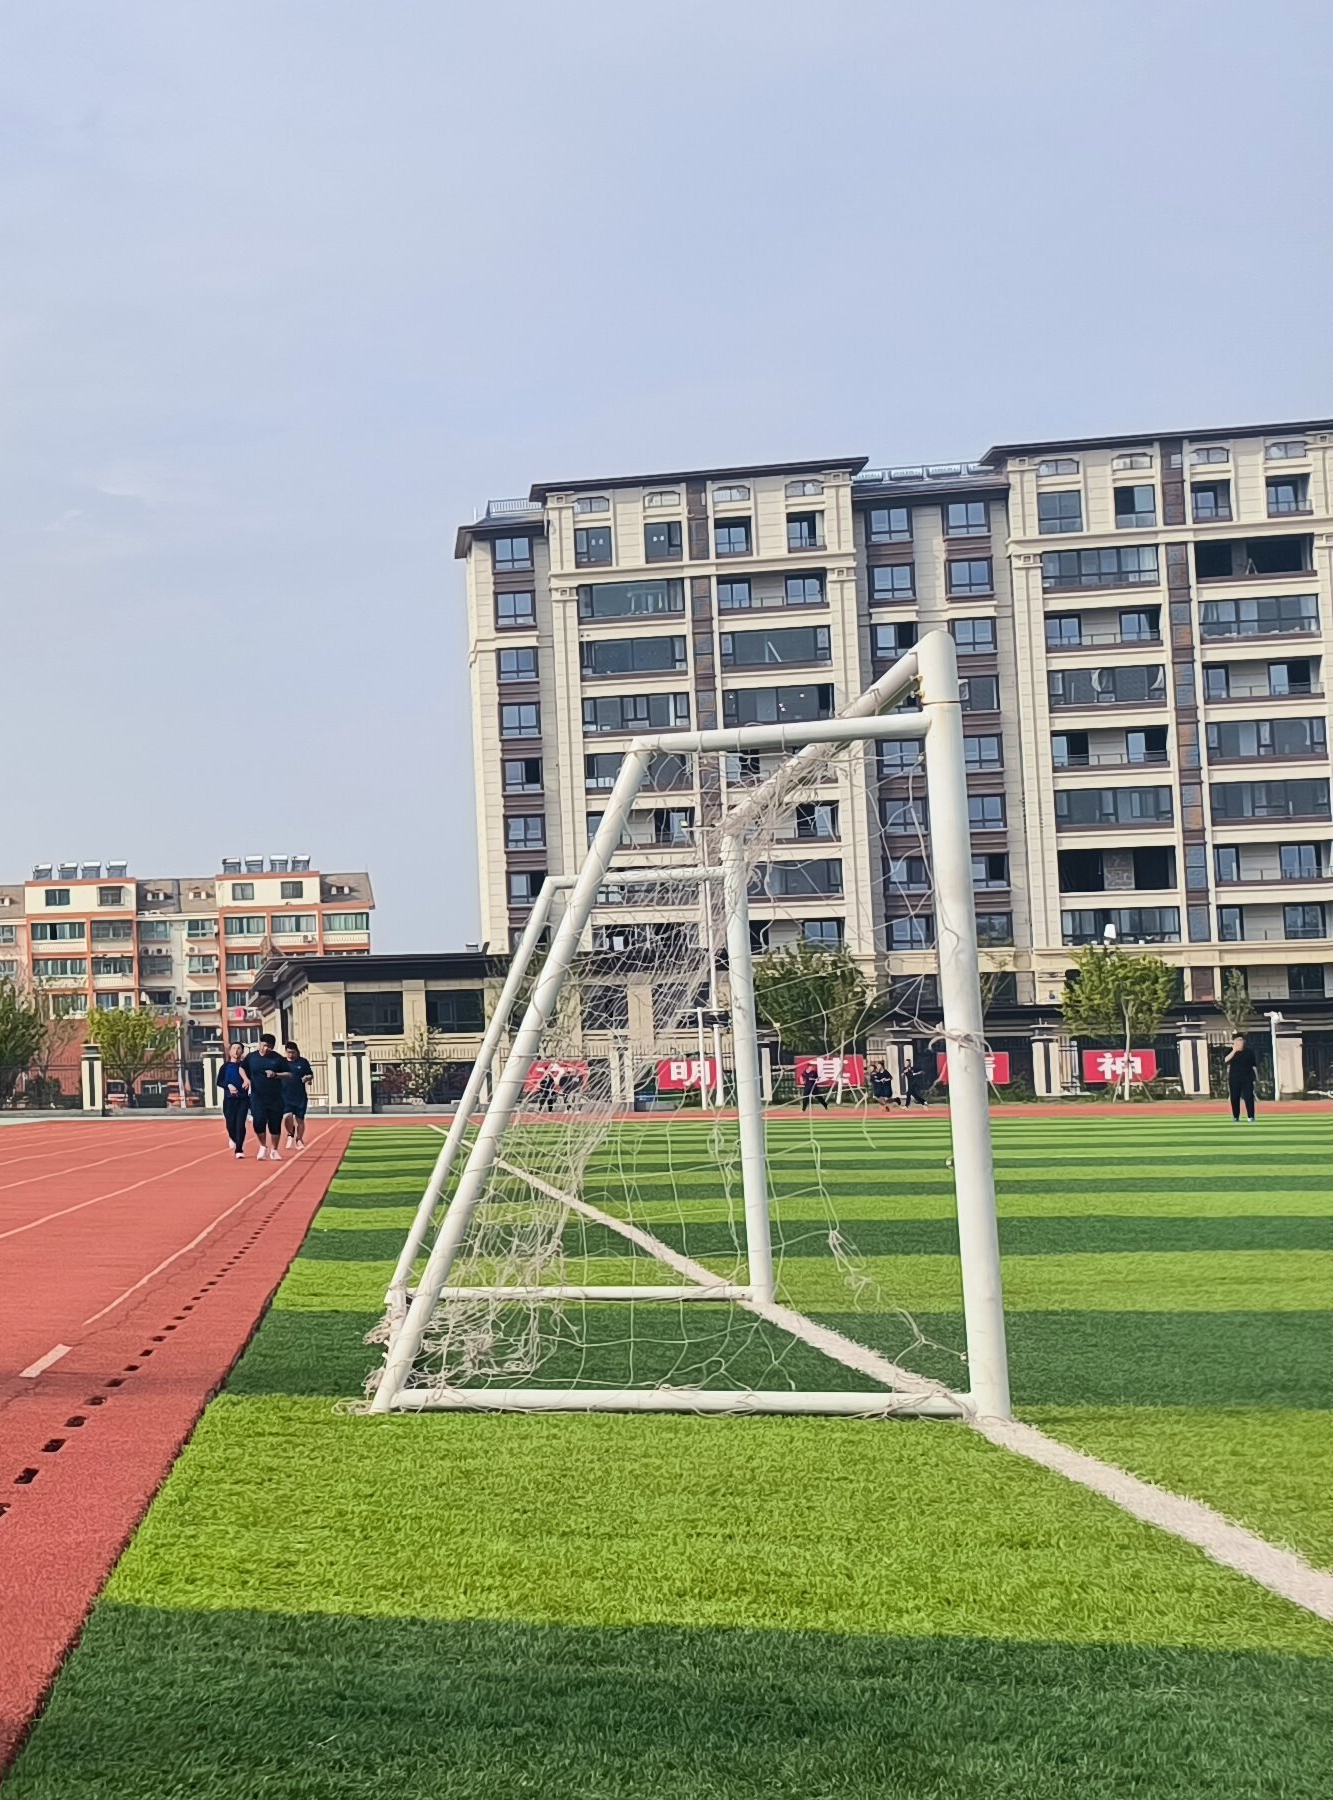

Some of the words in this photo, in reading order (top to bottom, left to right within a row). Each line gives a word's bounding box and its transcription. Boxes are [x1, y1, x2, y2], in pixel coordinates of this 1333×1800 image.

[670, 1060, 711, 1087] 明
[810, 1057, 850, 1085] 其
[1096, 1052, 1141, 1079] 神
